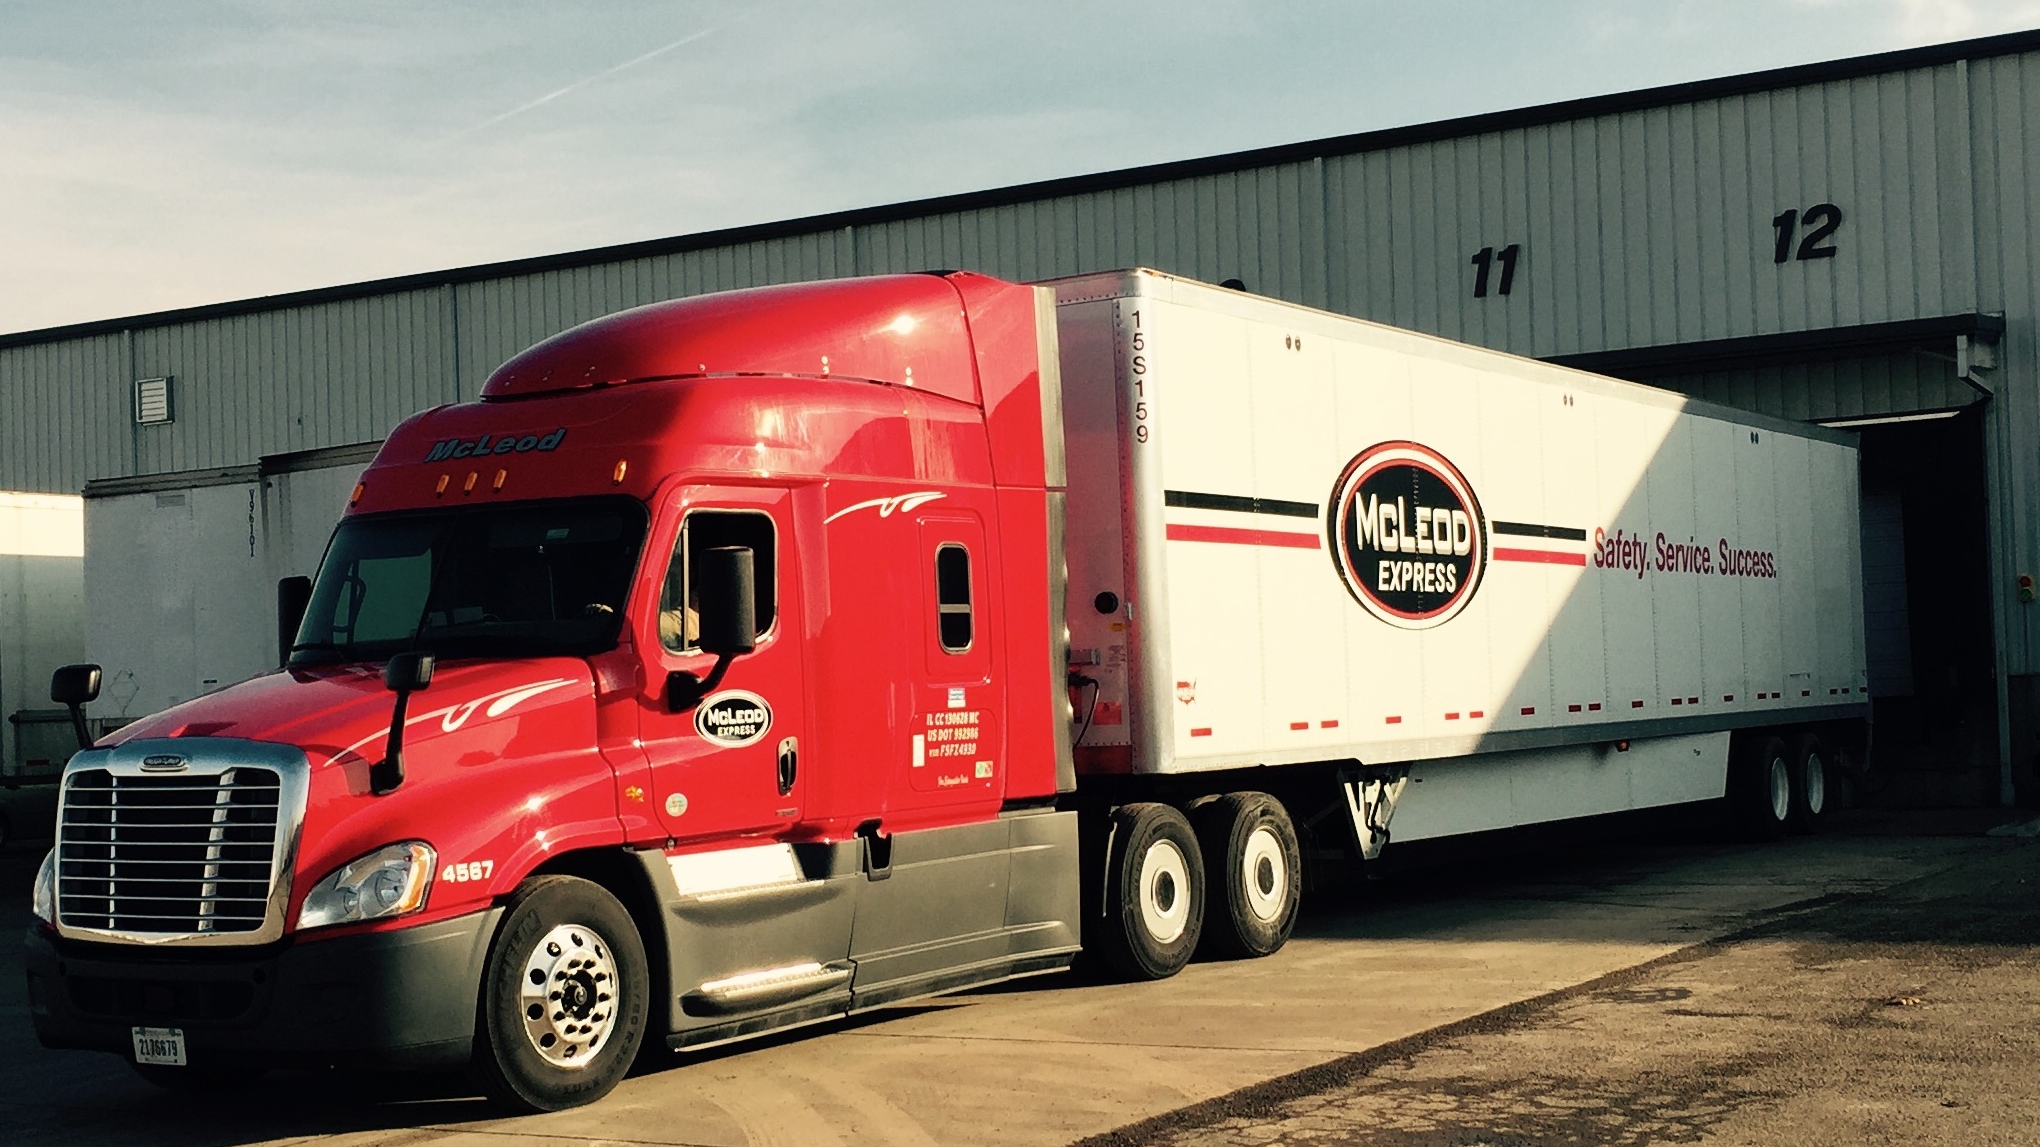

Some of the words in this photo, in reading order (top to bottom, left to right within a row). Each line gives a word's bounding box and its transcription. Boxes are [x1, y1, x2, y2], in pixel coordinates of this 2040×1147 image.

[1772, 203, 1842, 263] 12
[1471, 244, 1520, 298] 11
[1131, 310, 1149, 444] 15S159
[423, 427, 567, 464] McLeod
[1593, 526, 1650, 580] Safety.
[1655, 532, 1714, 575] Service.
[1718, 537, 1777, 579] Success.
[1378, 560, 1457, 594] EXPRESS
[717, 725, 756, 737] EXPRESS
[926, 713, 934, 726] IL
[935, 712, 945, 726] CC
[927, 729, 937, 742] US
[938, 728, 953, 741] DOT
[442, 859, 494, 884] 4567
